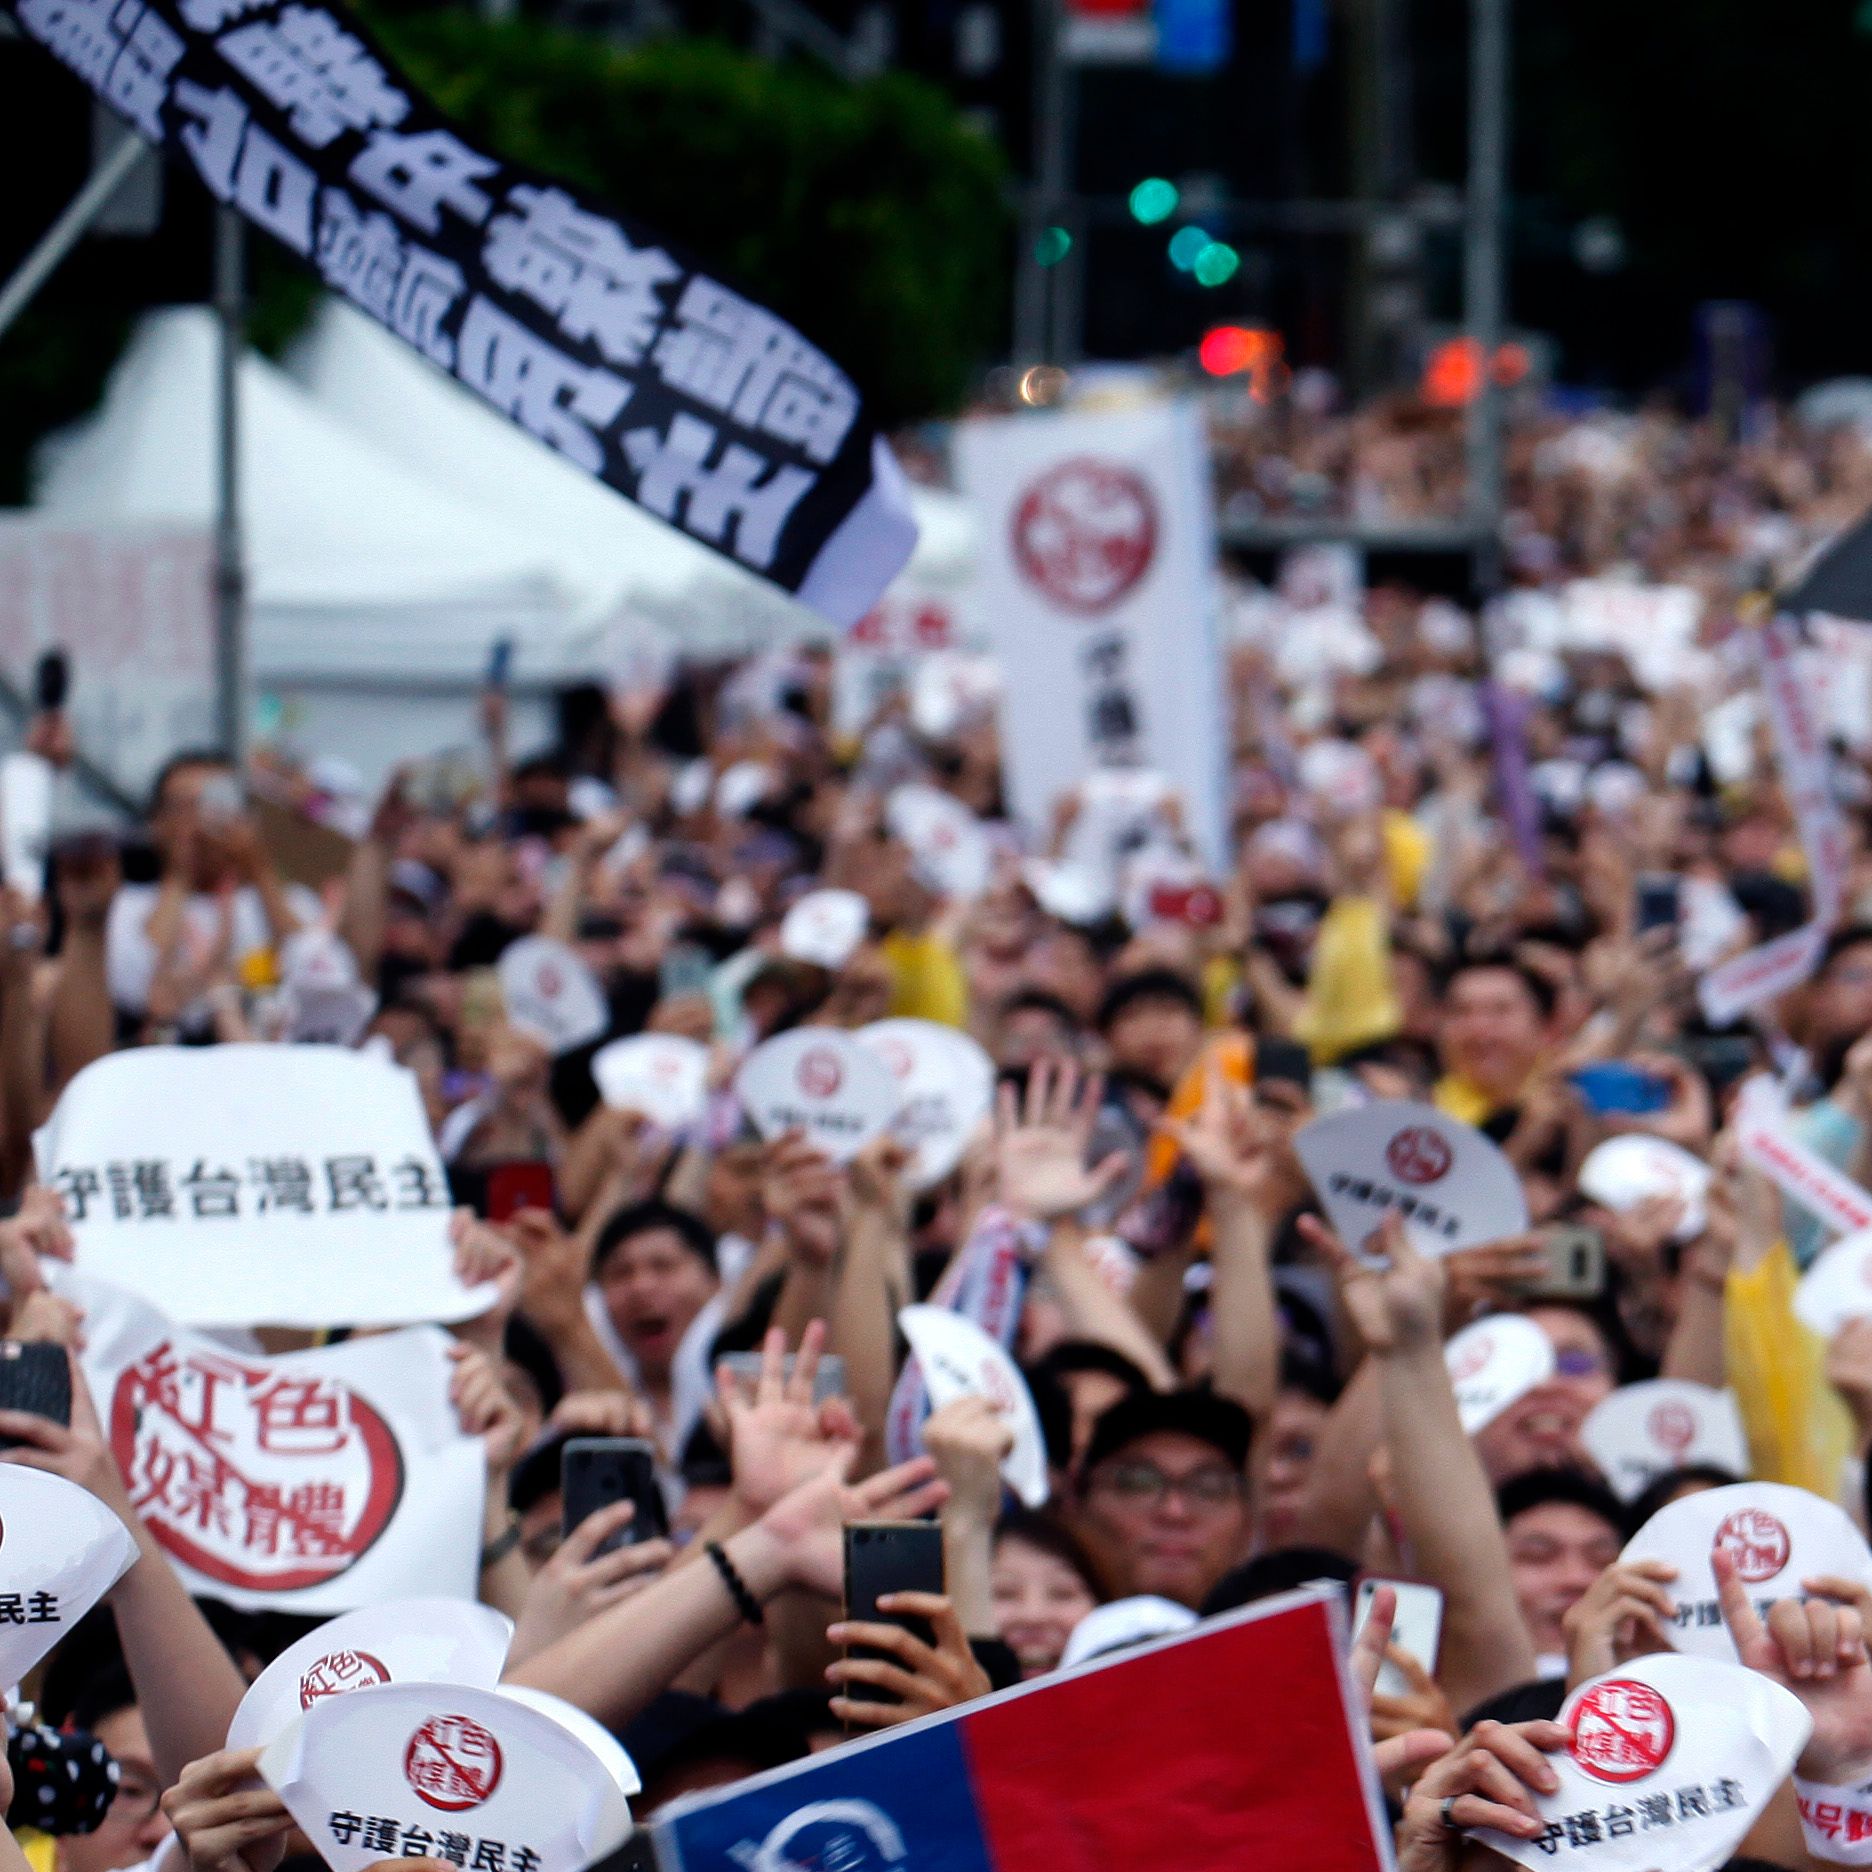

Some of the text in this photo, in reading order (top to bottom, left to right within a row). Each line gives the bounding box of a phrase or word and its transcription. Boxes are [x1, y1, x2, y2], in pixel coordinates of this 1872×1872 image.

[56, 1155, 451, 1222] 守護台灣民主
[1534, 1778, 1748, 1857] 守護台灣民主
